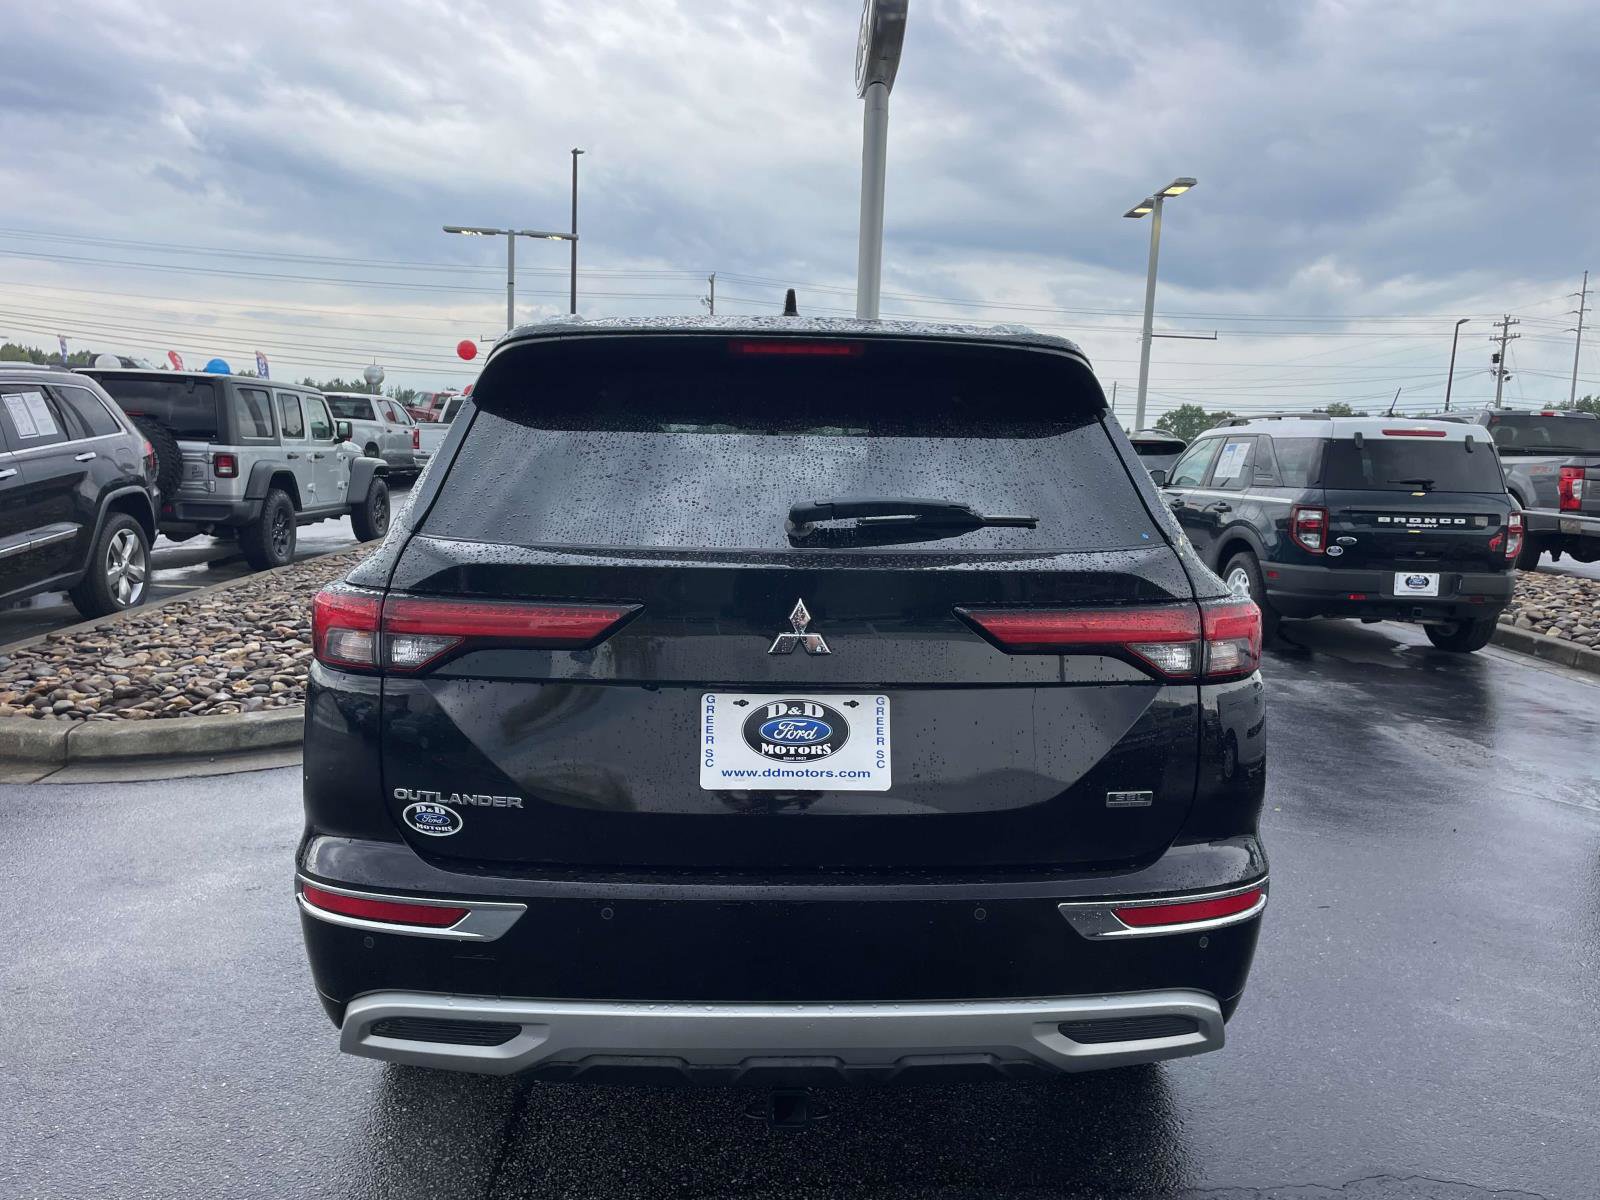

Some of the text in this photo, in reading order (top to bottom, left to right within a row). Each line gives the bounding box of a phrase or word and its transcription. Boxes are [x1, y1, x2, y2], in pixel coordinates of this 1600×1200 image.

[767, 702, 825, 719] D&D
[705, 694, 716, 767] GREER SC
[774, 721, 817, 740] Ford
[876, 697, 885, 769] GREER SC
[761, 743, 832, 755] MOTORS
[721, 768, 871, 778] www.ddmotors.com
[393, 788, 524, 808] OUTLANDER
[416, 805, 446, 815] D&D
[421, 815, 443, 824] Ford
[416, 823, 453, 831] MOTORS
